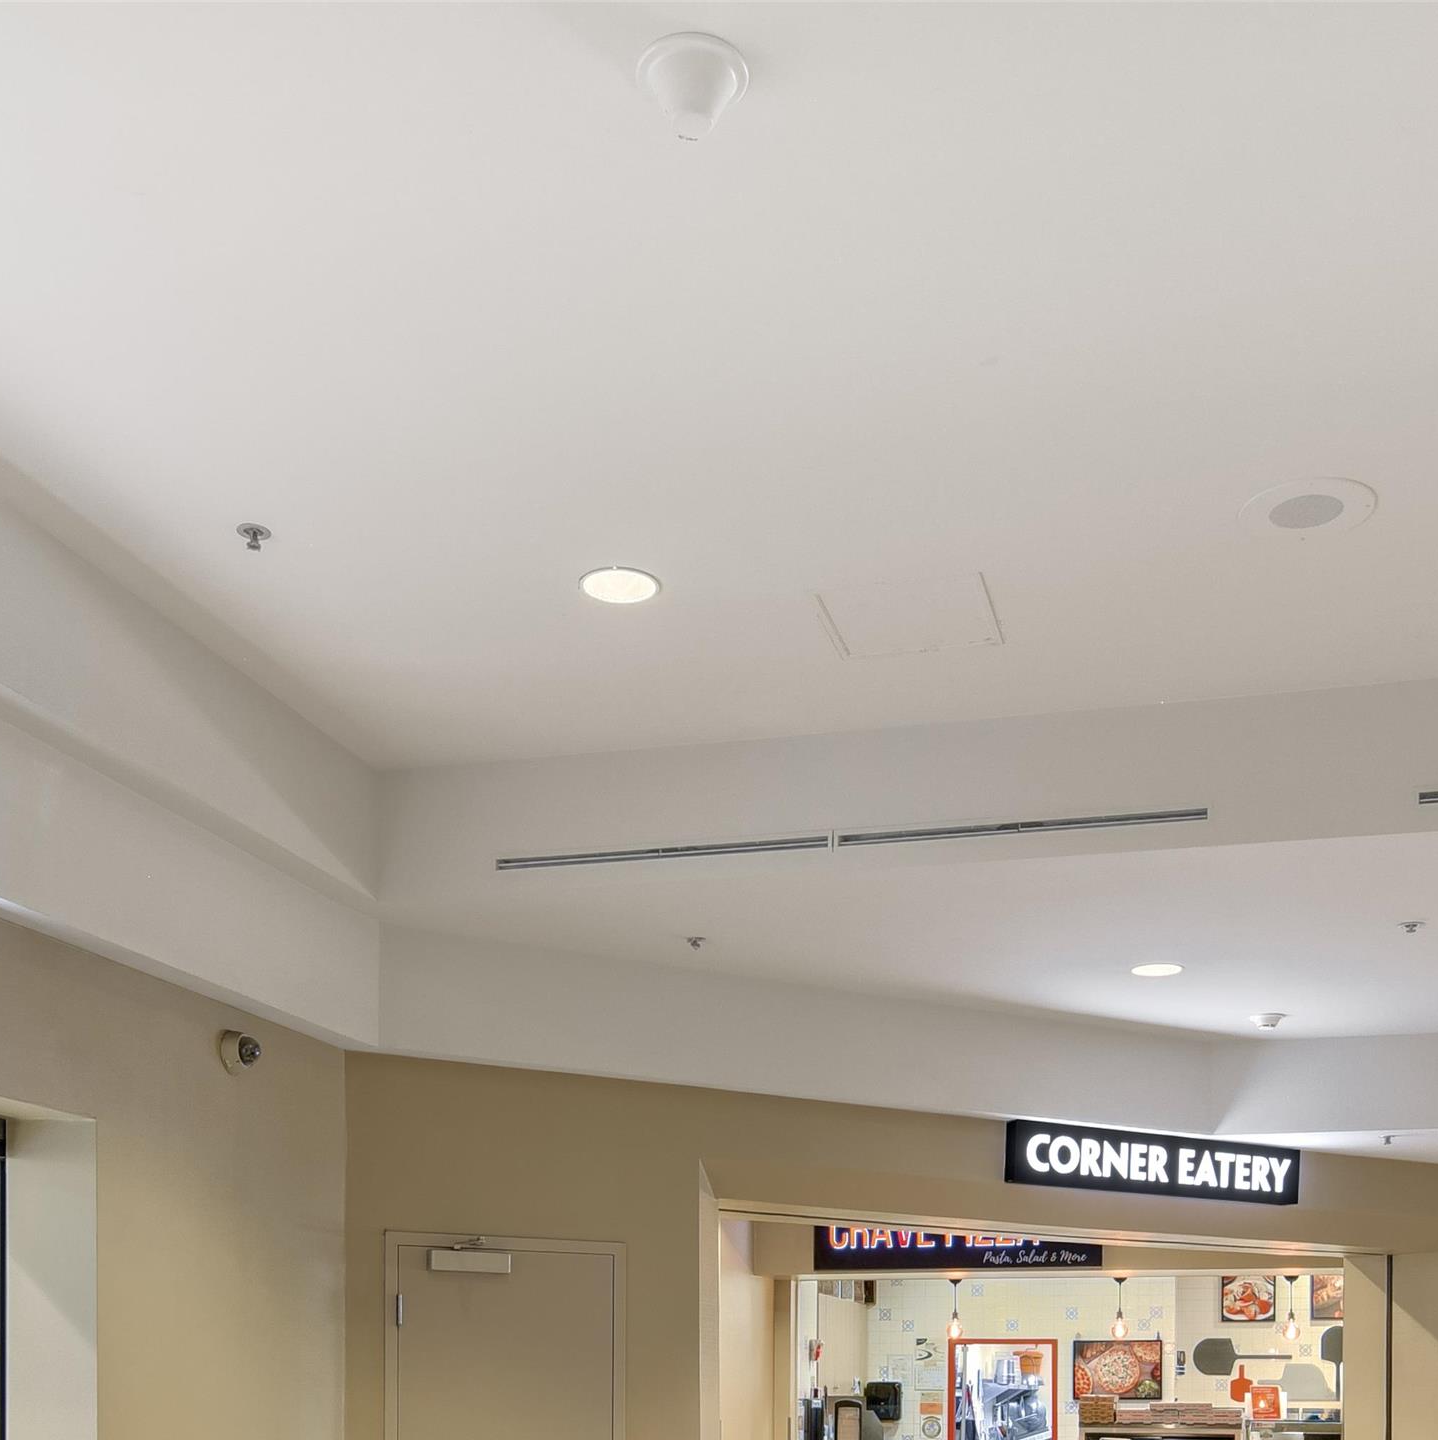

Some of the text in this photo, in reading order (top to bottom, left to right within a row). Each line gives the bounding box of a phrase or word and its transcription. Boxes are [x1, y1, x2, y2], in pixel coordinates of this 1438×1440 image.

[1025, 1132, 1292, 1194] CORNER EATERY
[983, 1251, 1013, 1265] Pasta,
[1016, 1249, 1048, 1264] Salad
[1059, 1250, 1087, 1264] More
